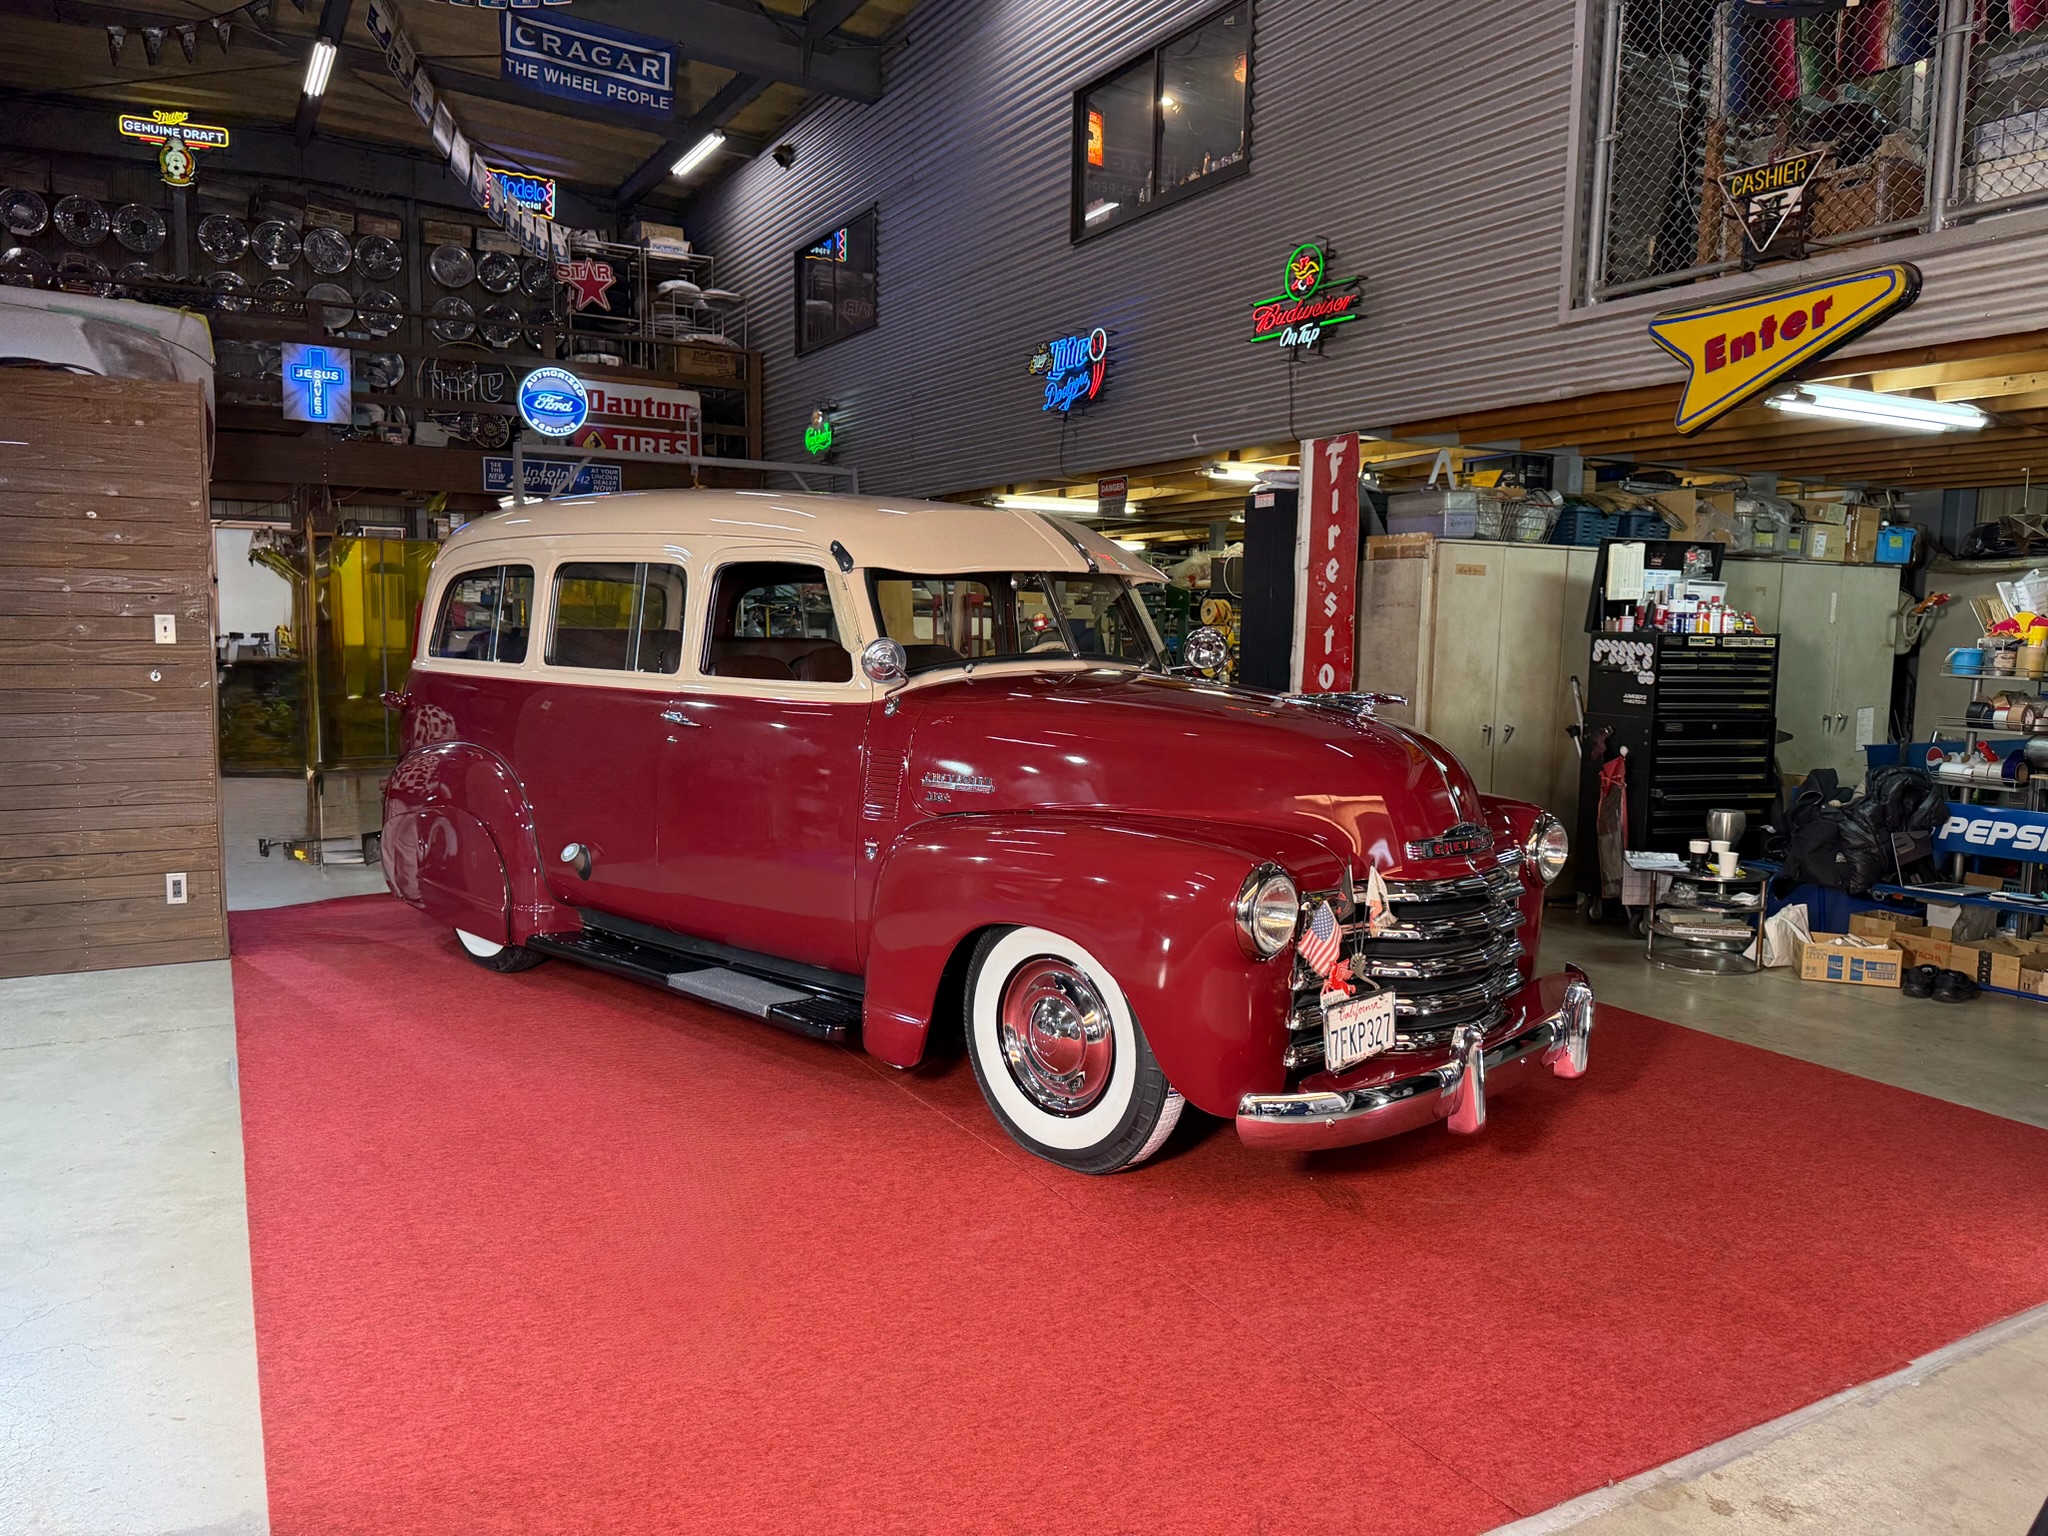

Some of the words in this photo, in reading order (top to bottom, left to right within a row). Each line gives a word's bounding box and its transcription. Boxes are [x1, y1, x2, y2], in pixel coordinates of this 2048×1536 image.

[515, 25, 661, 80] CRAGAR
[505, 57, 539, 80] THE
[544, 66, 602, 95] WHEEL
[606, 83, 671, 110] PEOPLE
[153, 110, 189, 125] Miller
[123, 120, 181, 138] GENUINE
[183, 128, 224, 144] DRAFT
[1732, 159, 1807, 197] CASHIER
[557, 258, 611, 280] STAR
[1252, 294, 1357, 333] Budweiser
[1280, 326, 1298, 347] On
[1297, 323, 1320, 349] Tap
[1705, 294, 1833, 375] Enter
[1046, 336, 1091, 381] Lite
[295, 368, 339, 380] JESUS
[526, 369, 584, 398] AUTHORIZED
[534, 393, 574, 412] Ford
[1042, 370, 1091, 411] Dodgers
[587, 390, 690, 420] Dayton
[531, 418, 577, 434] SERVICE
[613, 434, 689, 455] TIRES
[488, 472, 506, 480] NEW
[1101, 482, 1125, 493] DANGER
[1318, 439, 1348, 690] Firesto
[1338, 998, 1384, 1023] California
[1331, 1012, 1391, 1062] 7FKP327
